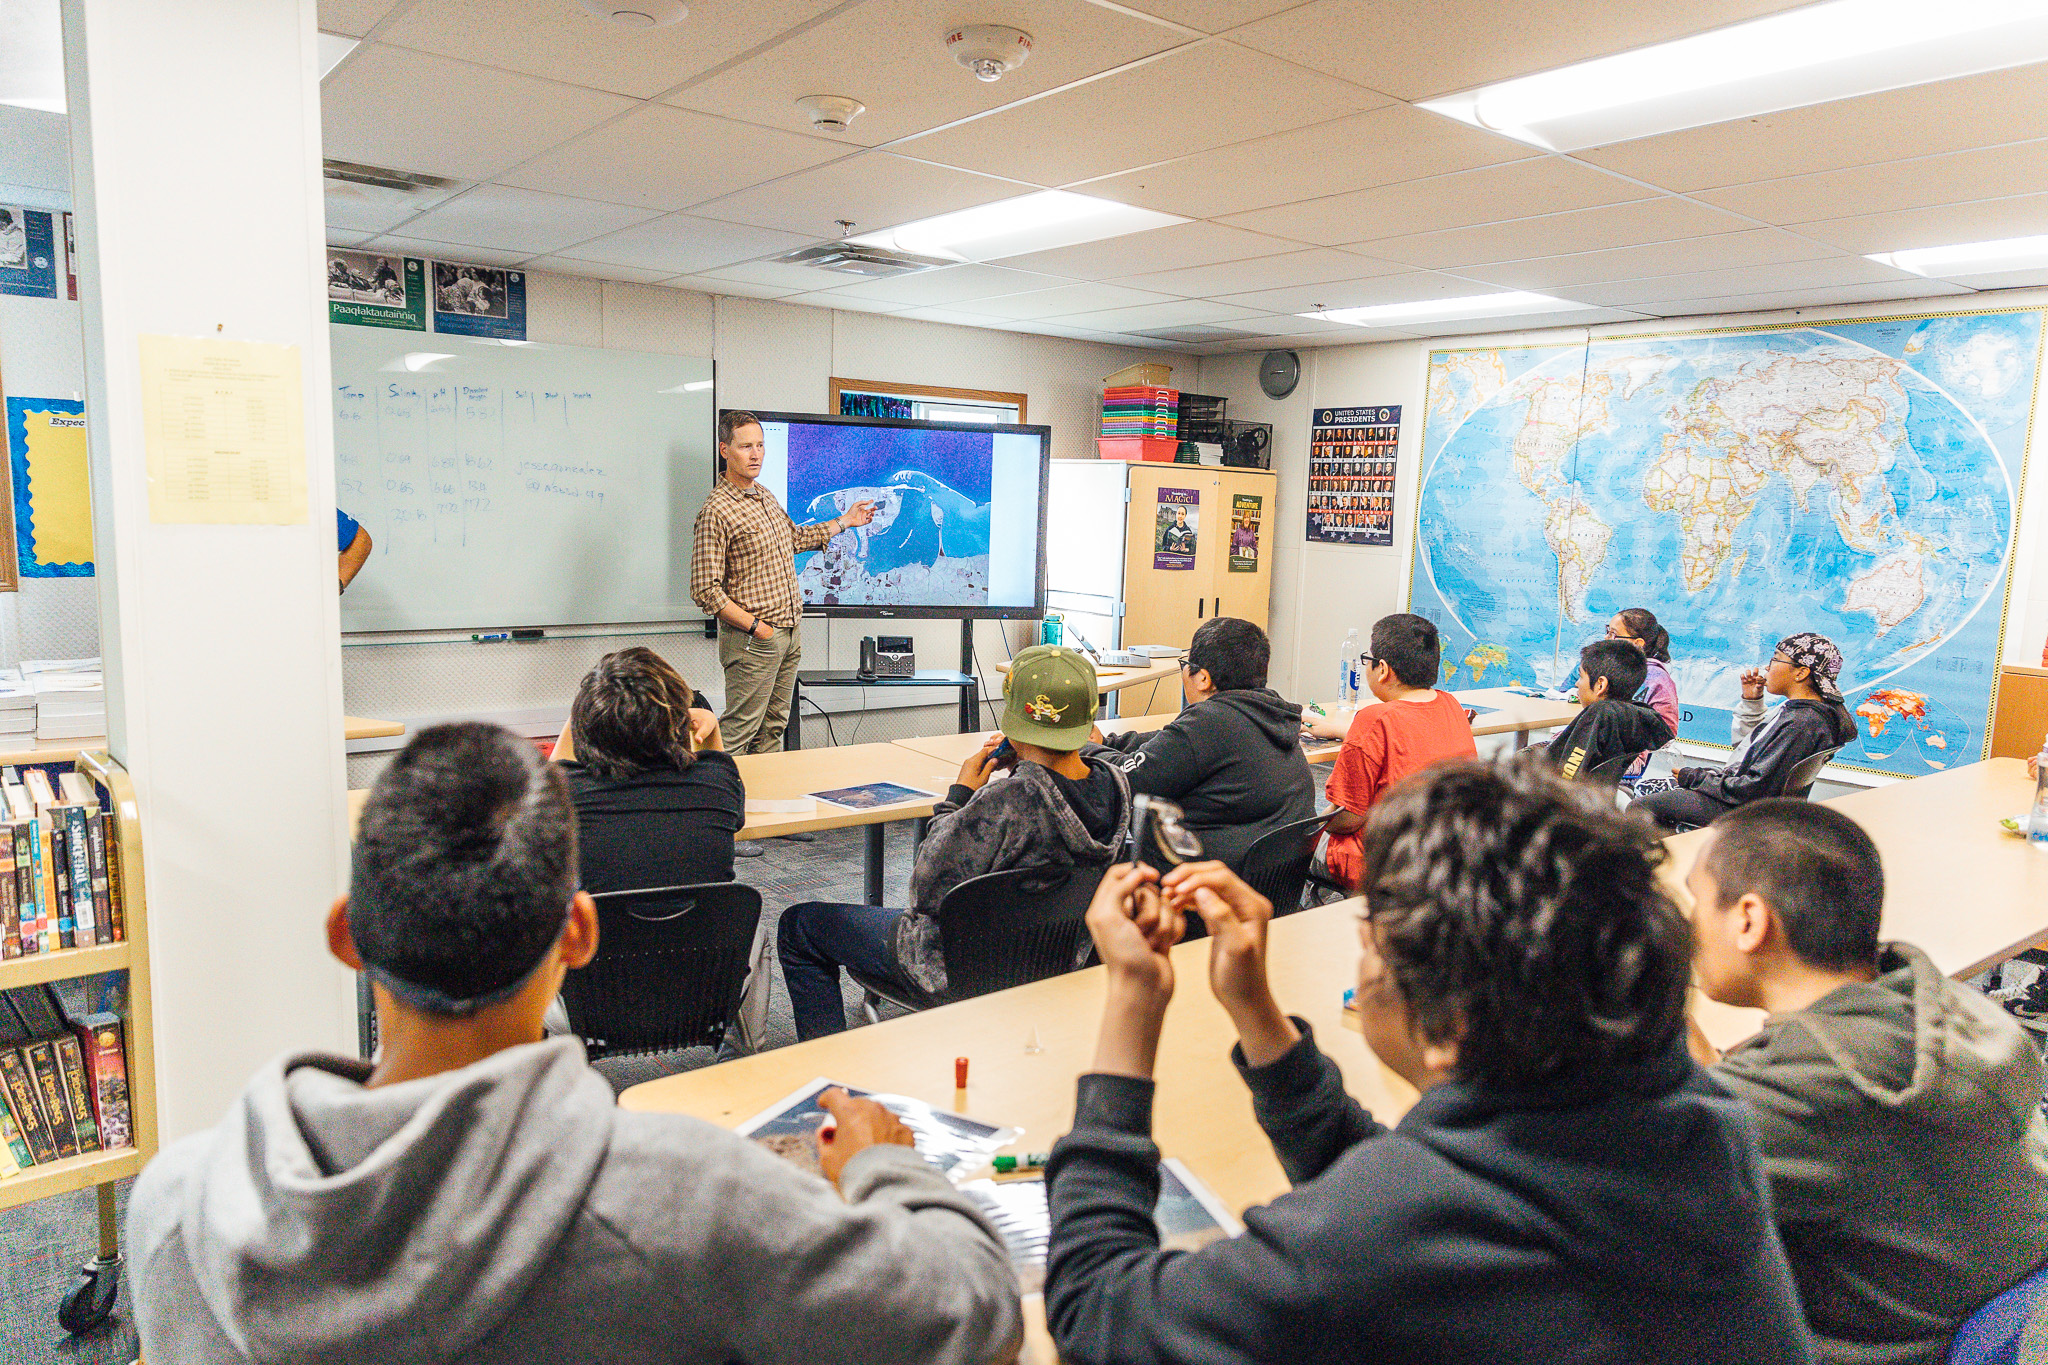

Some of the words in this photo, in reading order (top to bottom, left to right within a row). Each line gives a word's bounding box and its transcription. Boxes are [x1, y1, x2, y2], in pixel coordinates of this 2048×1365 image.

[945, 31, 964, 48] FIRE
[433, 388, 446, 399] pH
[1334, 415, 1376, 424] PRESIDENTS
[1164, 495, 1194, 504] MAGIC!
[1860, 587, 1915, 597] AUSTRALIA
[72, 825, 85, 857] SHOCK
[75, 863, 88, 884] FALL
